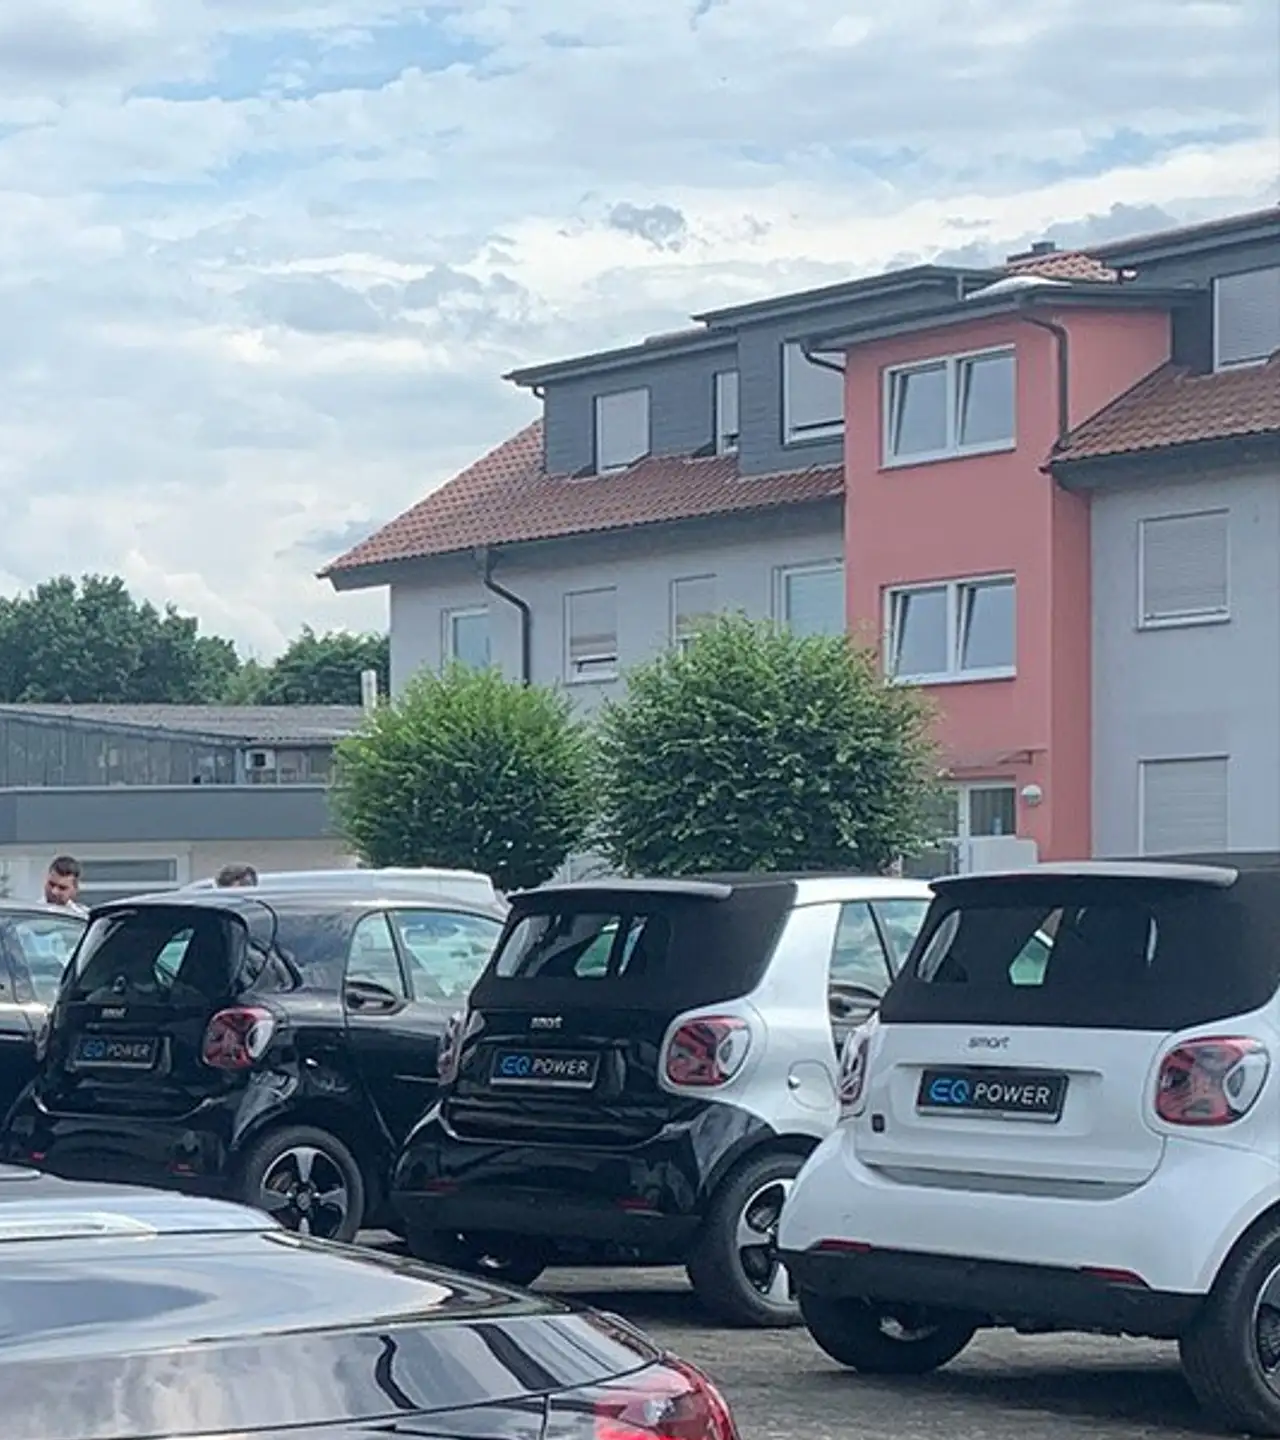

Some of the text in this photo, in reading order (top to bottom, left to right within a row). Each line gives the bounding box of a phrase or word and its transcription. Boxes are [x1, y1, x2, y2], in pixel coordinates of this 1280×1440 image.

[968, 1035, 1011, 1049] smart
[501, 1055, 589, 1076] EQ POWER
[929, 1078, 1052, 1106] EQ POWER
